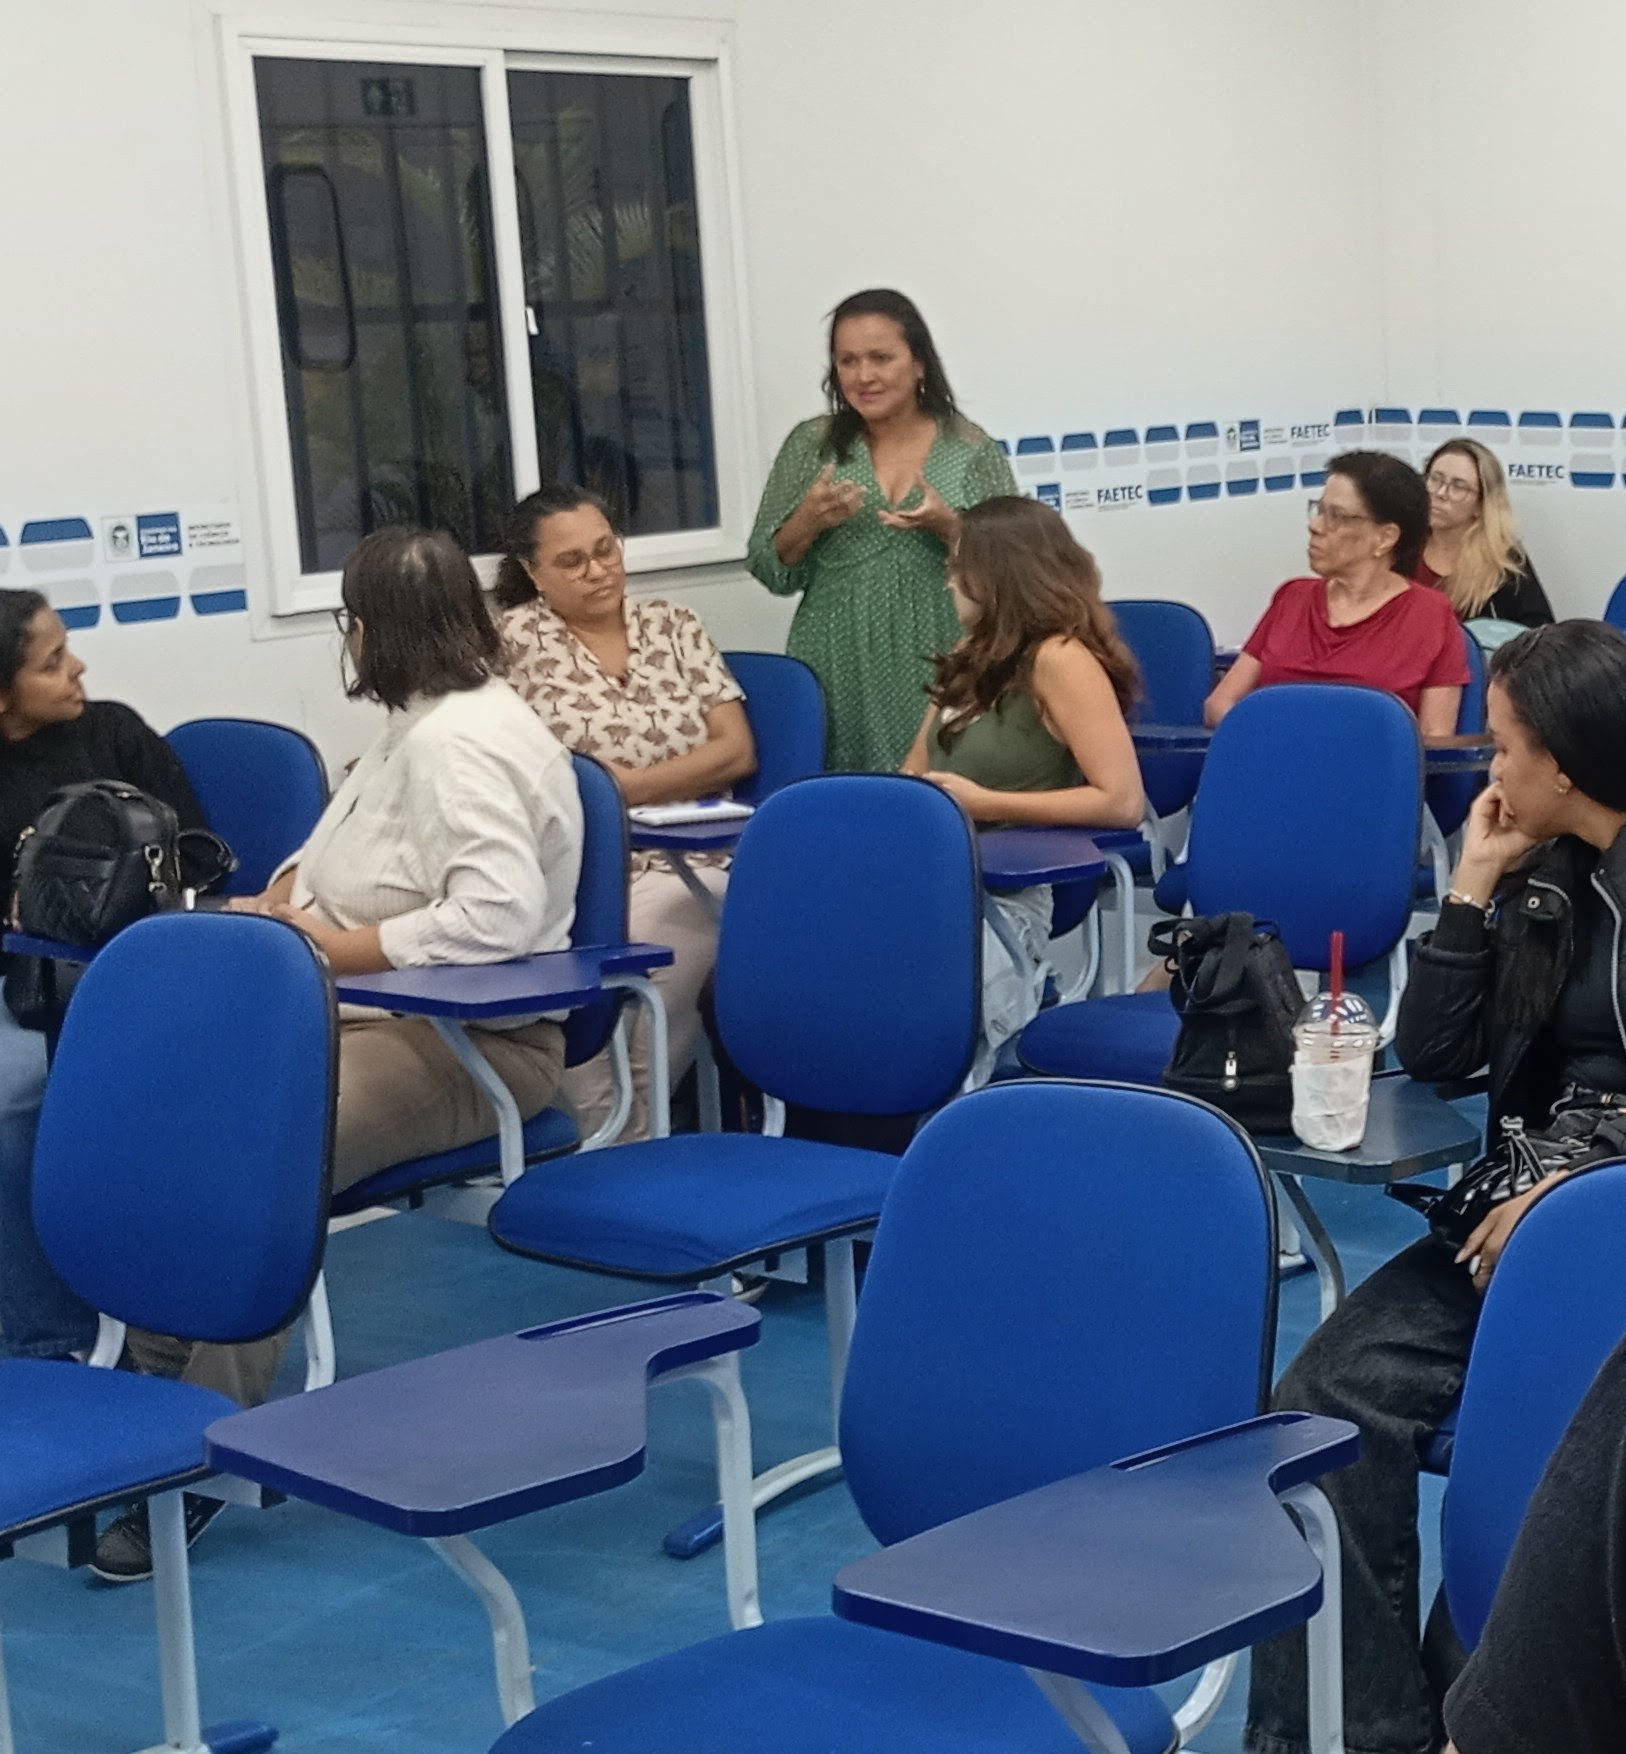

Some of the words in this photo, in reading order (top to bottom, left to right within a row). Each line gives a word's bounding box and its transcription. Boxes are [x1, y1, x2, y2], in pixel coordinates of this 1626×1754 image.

[1290, 424, 1331, 440] FAETEC
[1508, 464, 1565, 479] FAETEC
[1097, 484, 1143, 504] FAETEC
